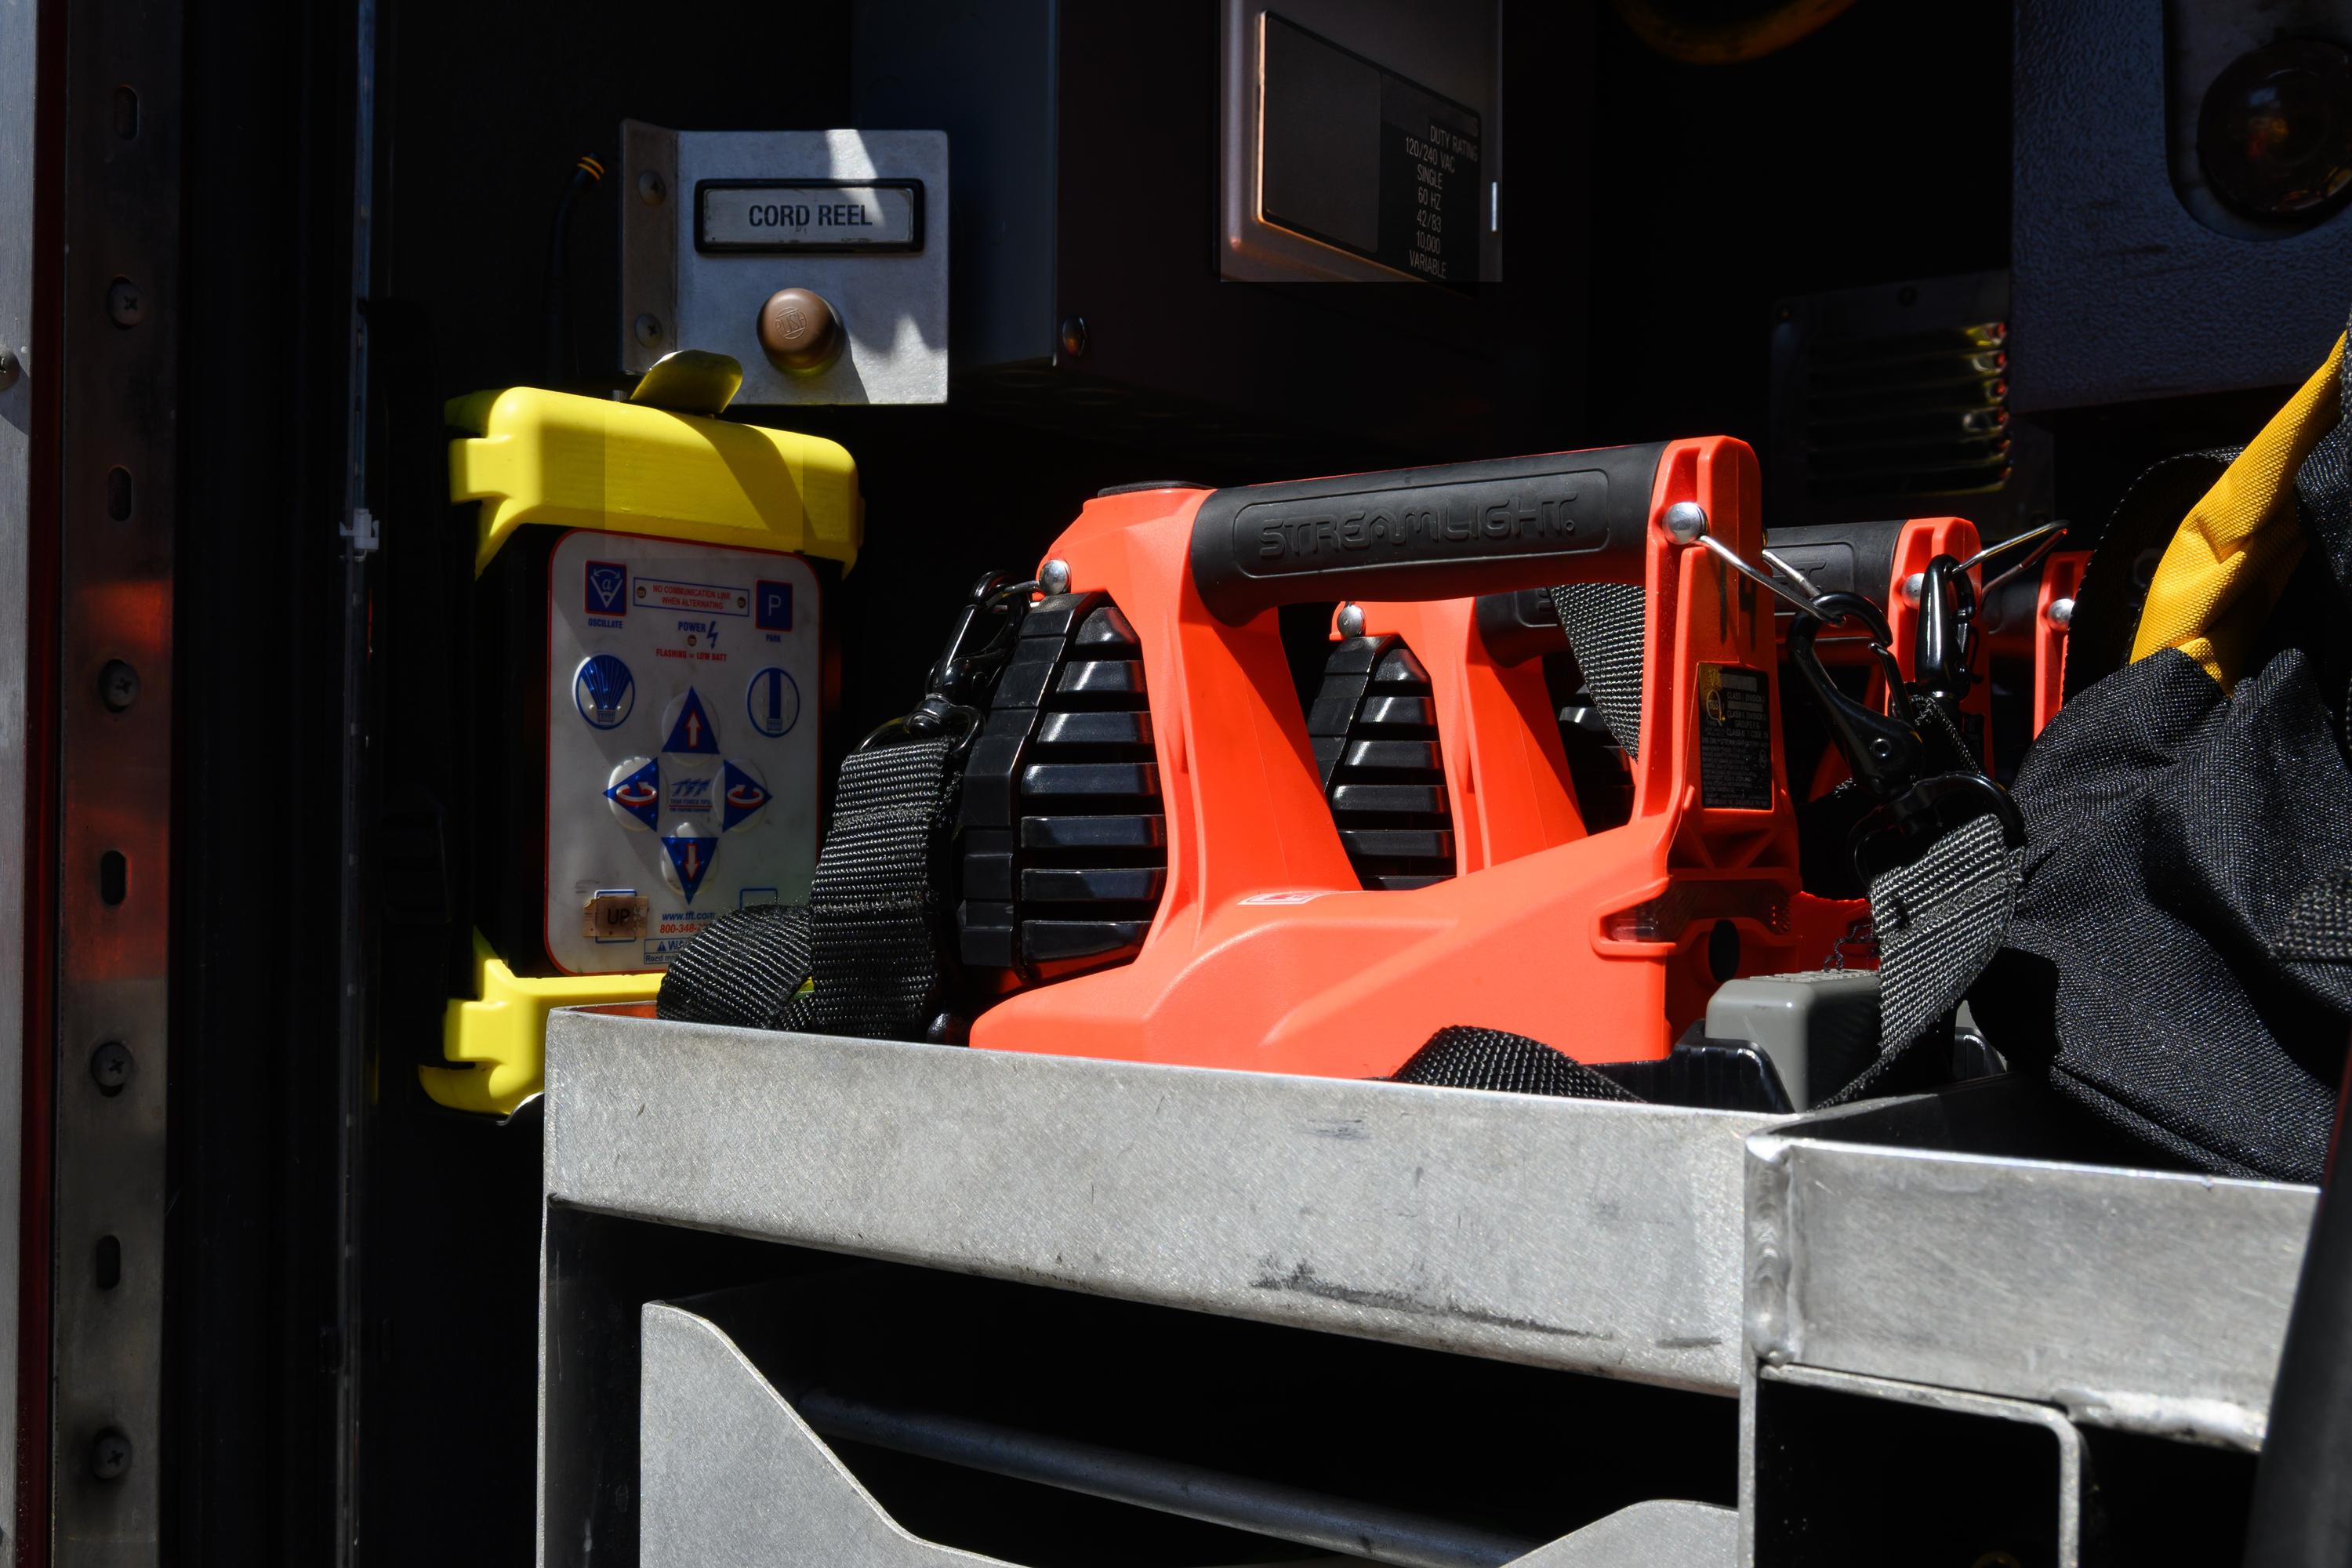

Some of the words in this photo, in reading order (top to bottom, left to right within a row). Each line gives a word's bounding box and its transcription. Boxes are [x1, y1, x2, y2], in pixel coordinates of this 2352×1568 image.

[1406, 136, 1439, 166] 120/240
[1440, 153, 1456, 173] VAC
[1430, 125, 1451, 149] DUTY
[1453, 136, 1479, 162] RATING
[1417, 163, 1443, 190] SINGLE
[1417, 187, 1428, 205] 60
[1430, 192, 1442, 211] HZ
[749, 205, 810, 227] CORD
[818, 205, 873, 226] REEL
[1417, 209, 1442, 233] 42/83
[1417, 231, 1441, 255] 10,000
[1409, 249, 1447, 279] VARIABLE
[1259, 492, 1577, 559] STREAMLIGHT
[664, 586, 716, 598] COMMUNICATION
[717, 591, 731, 600] LINK
[681, 598, 724, 609] ALTERNATING
[768, 593, 782, 616] P
[588, 618, 623, 629] OSCILLATE
[678, 621, 706, 633] POWER
[765, 633, 782, 643] PARK
[656, 648, 687, 659] FLASHING
[696, 652, 710, 660] LOW
[712, 653, 728, 662] BATT
[607, 908, 630, 925] UP
